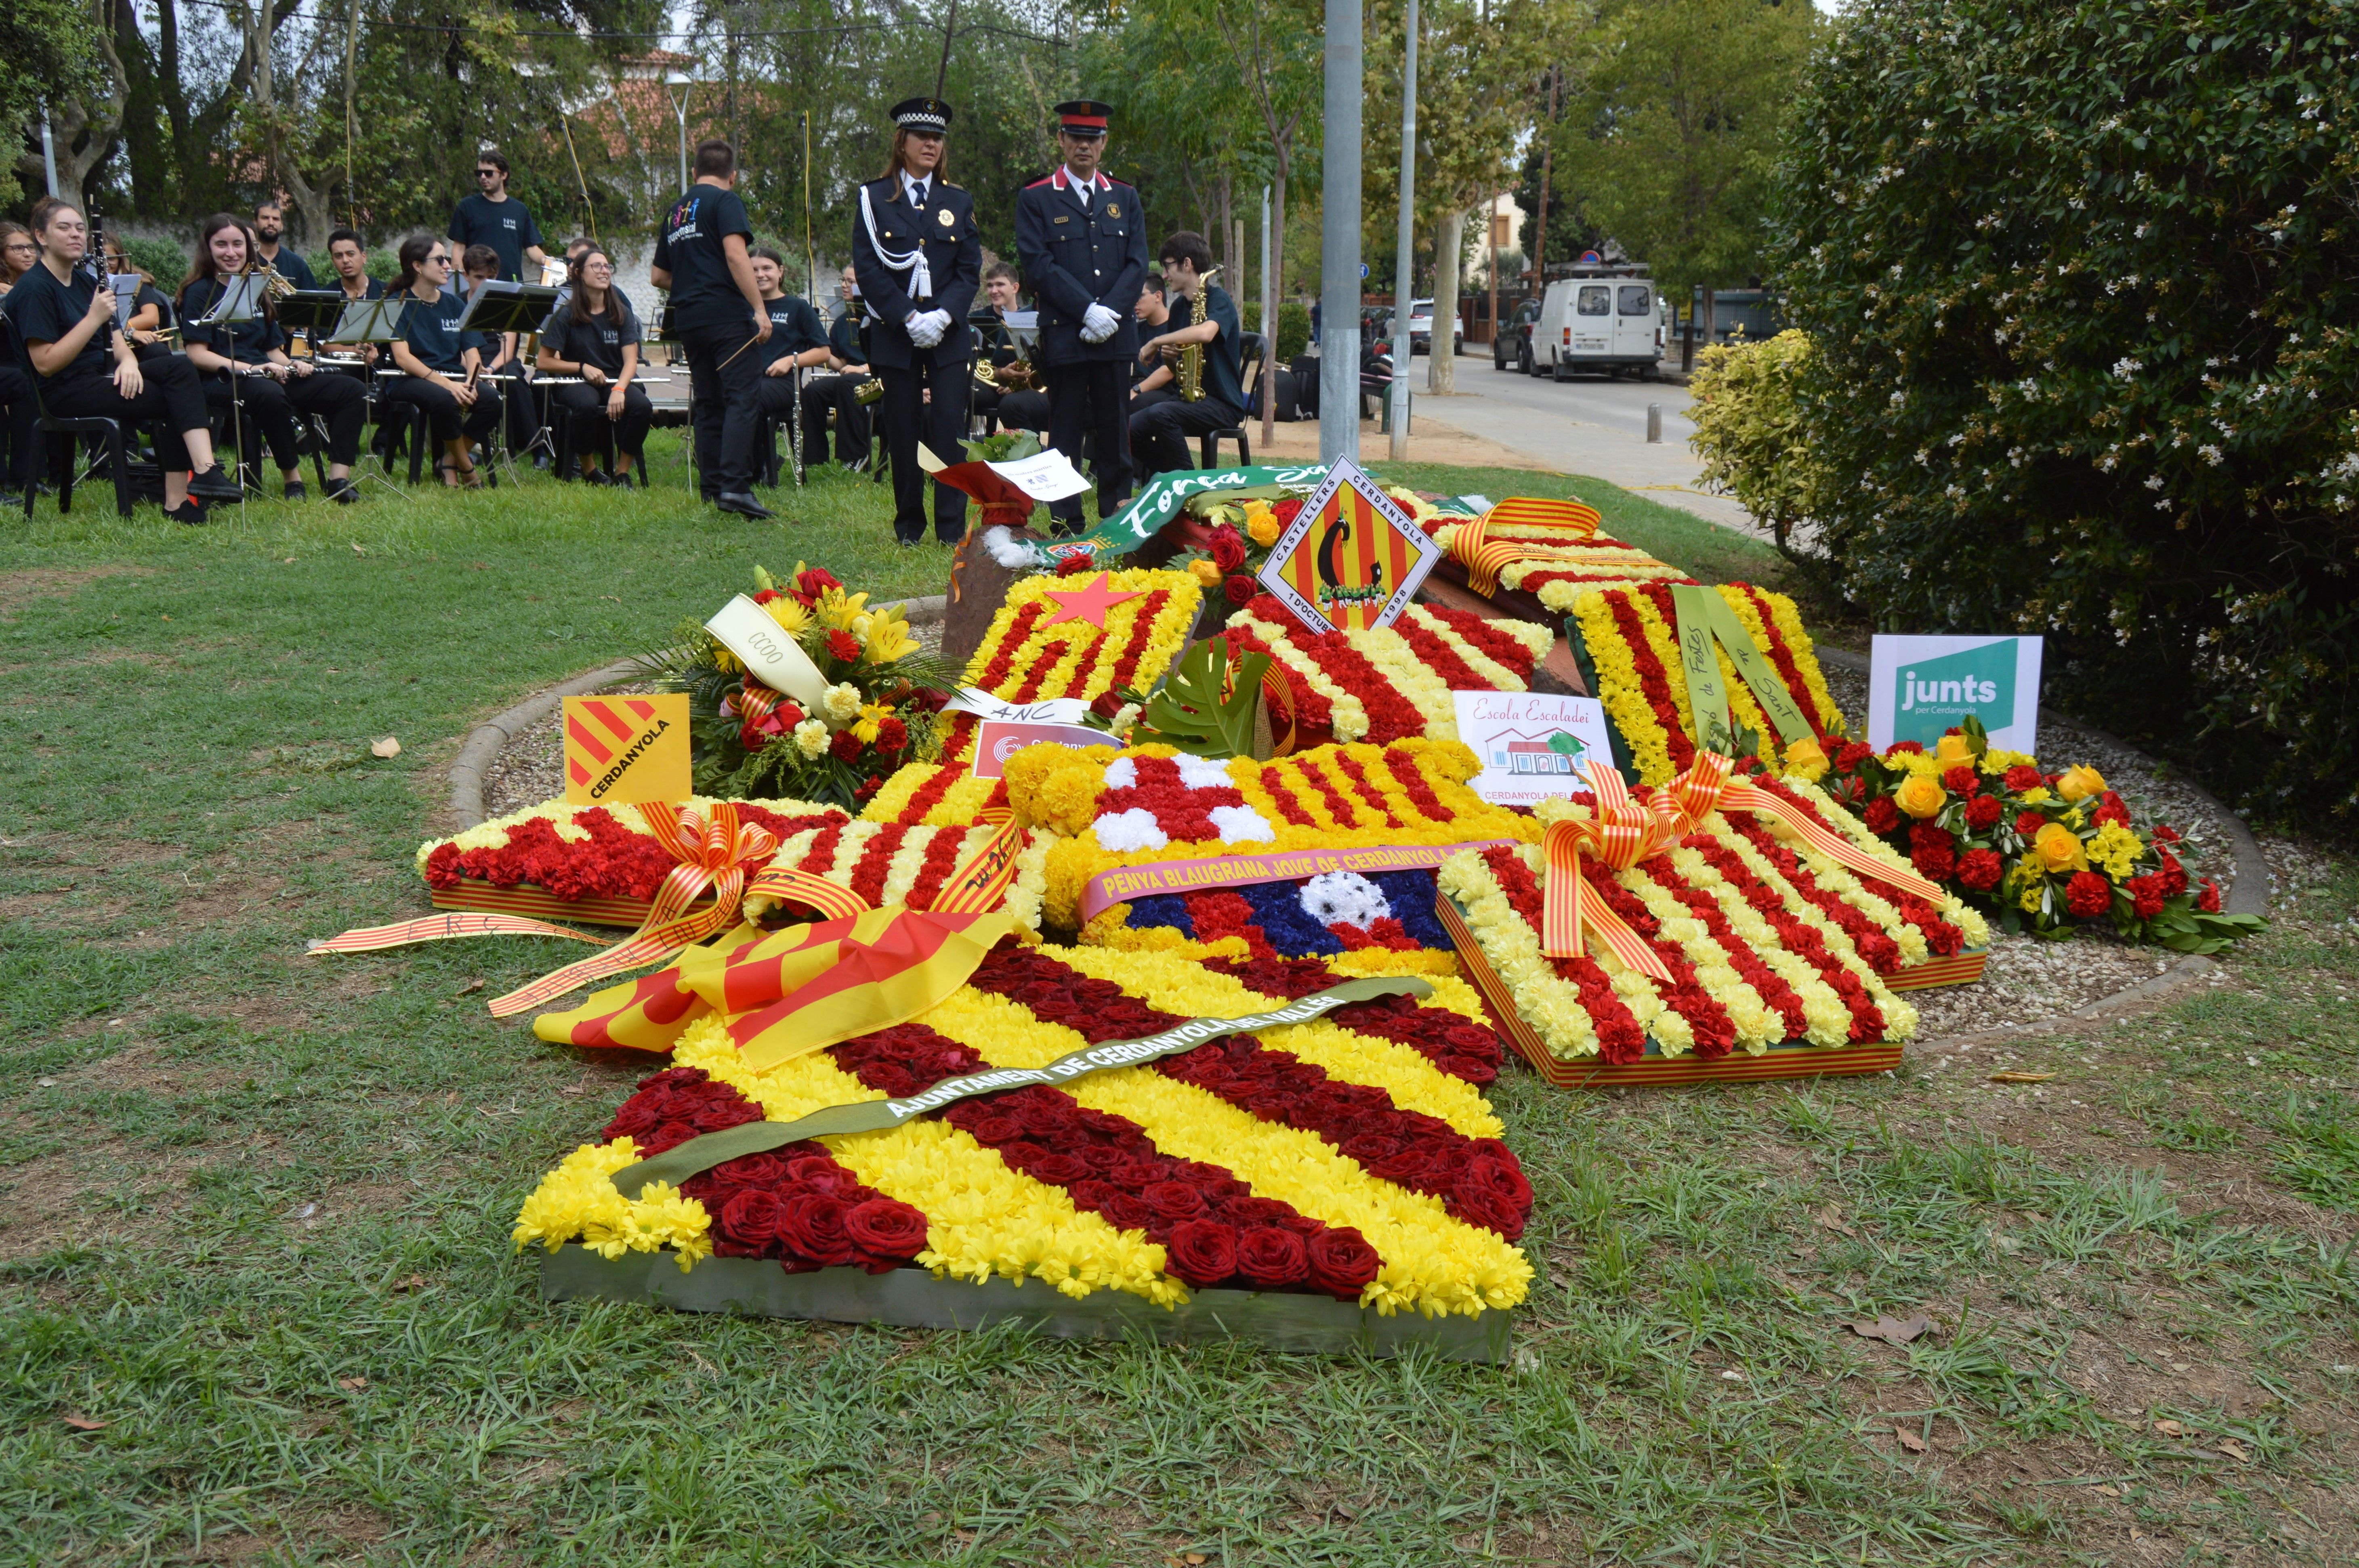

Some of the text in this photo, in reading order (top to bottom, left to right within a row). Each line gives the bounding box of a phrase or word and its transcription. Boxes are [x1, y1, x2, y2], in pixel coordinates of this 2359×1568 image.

[1120, 472, 1247, 538] Força
[1276, 479, 1335, 561] CASTELLERS
[1353, 475, 1422, 545] CERDANYOLA
[1384, 589, 1406, 619] 1998
[748, 632, 783, 663] CCOO
[1687, 624, 1710, 674] Festes
[1699, 682, 1714, 696] de
[1755, 677, 1798, 722] Sant
[1902, 671, 1996, 711] junts
[991, 703, 1055, 721] ANC
[1473, 698, 1590, 724] Escola Escaladei
[1931, 706, 1976, 715] Cerdanyola
[590, 719, 671, 800] CERDANYOLA
[1485, 791, 1549, 800] CERDANYOLA
[1101, 848, 1450, 899] PENYA BLAUGRANA JOVE DE CERDANYOLA
[886, 1070, 1054, 1118] AJUNTAMENT
[1050, 1057, 1095, 1076] DE
[1086, 1020, 1236, 1065] CERDANYOLA
[1228, 1015, 1275, 1029] DEL
